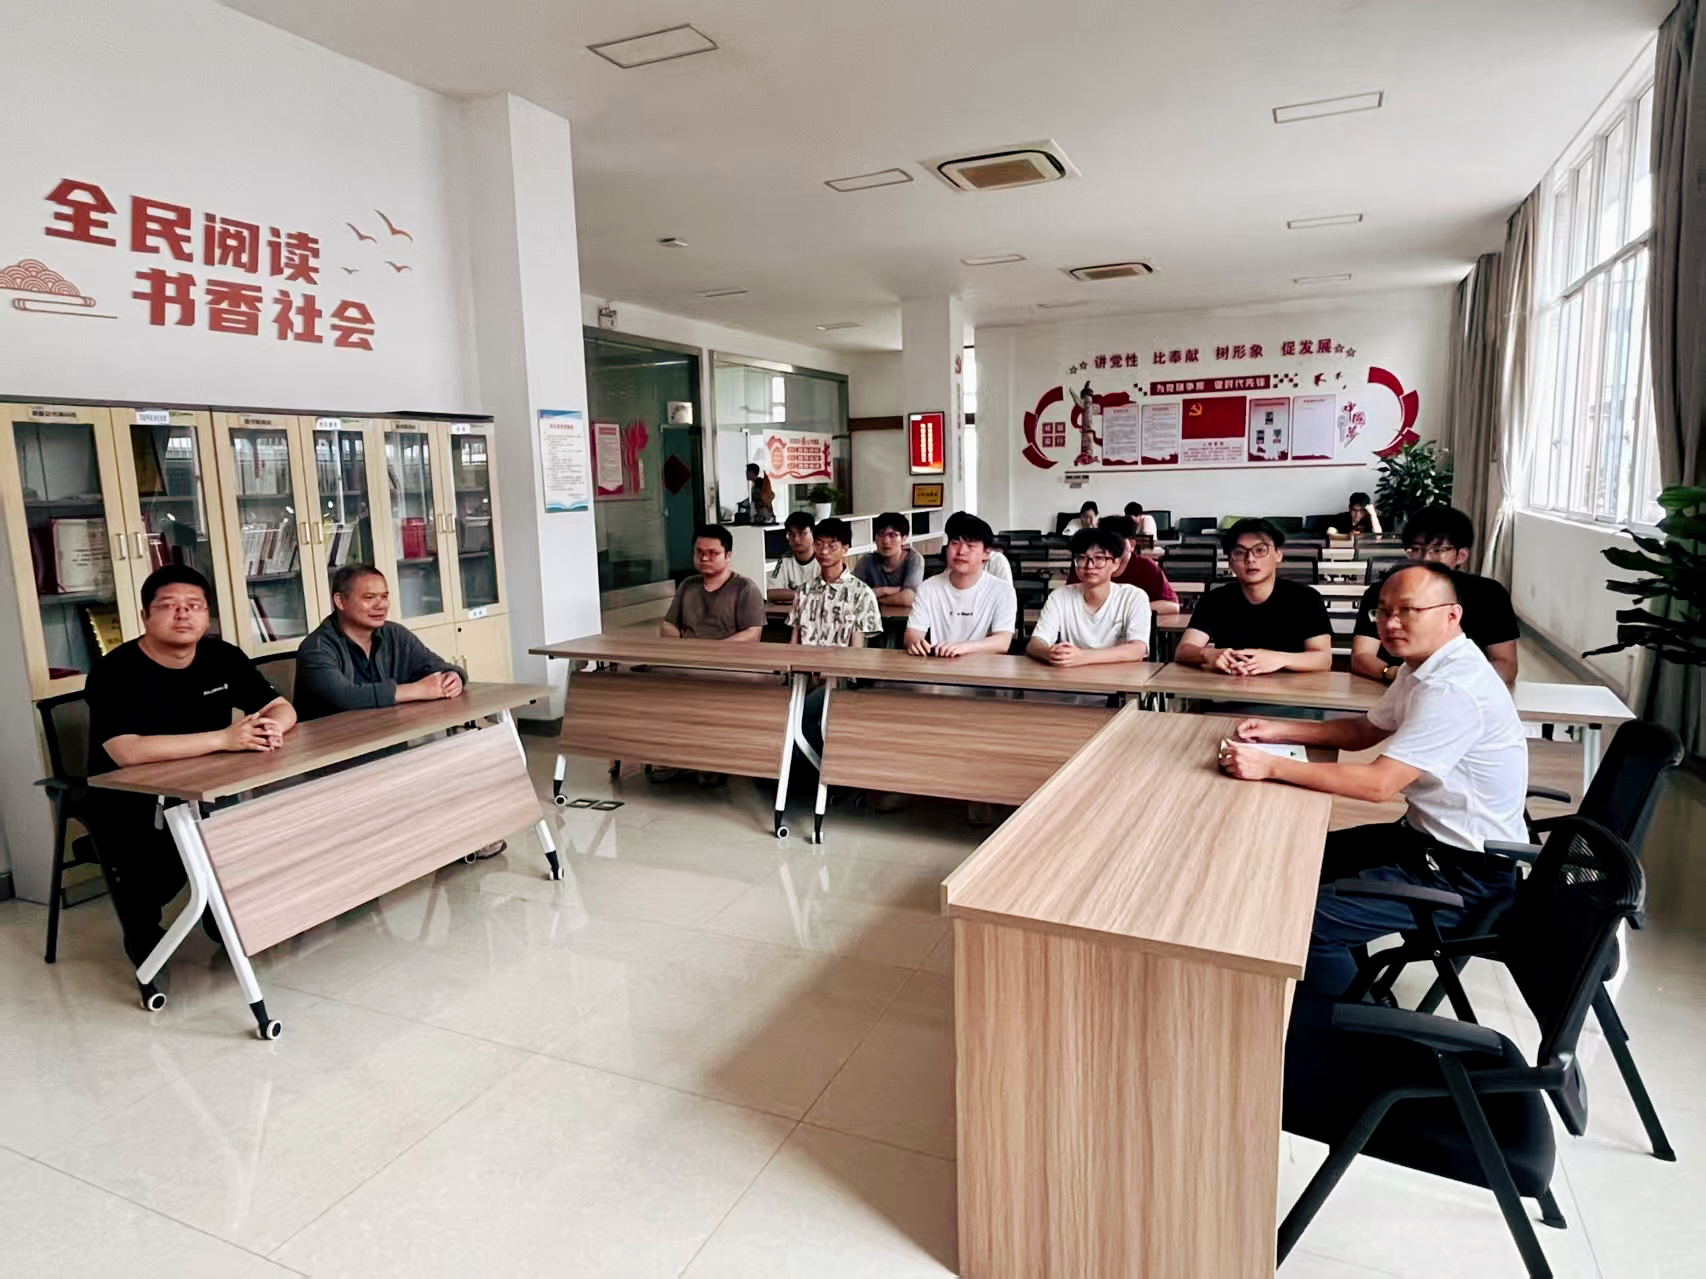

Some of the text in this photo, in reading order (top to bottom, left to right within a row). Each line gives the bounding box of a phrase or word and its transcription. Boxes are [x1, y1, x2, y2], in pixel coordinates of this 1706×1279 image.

[44, 178, 320, 285] 全民阅读
[132, 268, 375, 351] 书香社会
[1094, 339, 1332, 369] 讲党性 比奉献 树形象 促发展
